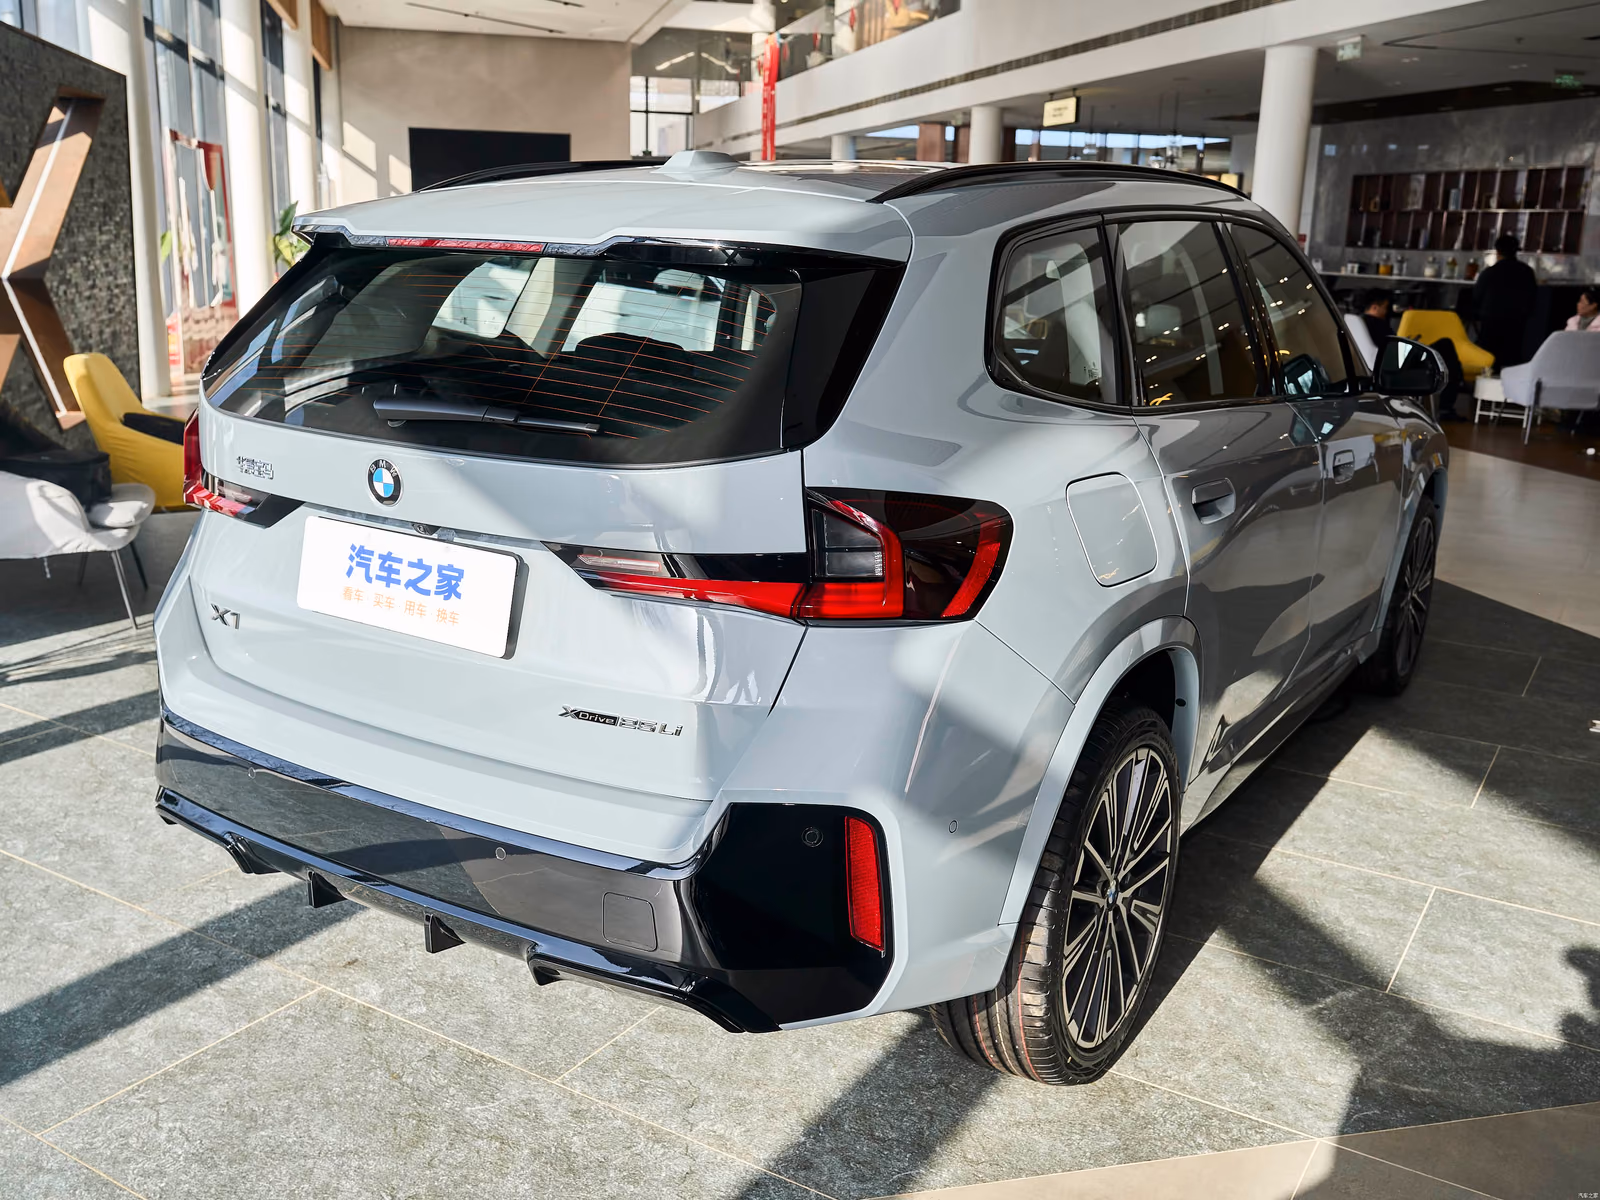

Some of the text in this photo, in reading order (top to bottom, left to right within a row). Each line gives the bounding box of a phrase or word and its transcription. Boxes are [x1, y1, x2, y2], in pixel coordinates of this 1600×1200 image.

[369, 459, 398, 477] BMW
[345, 543, 465, 601] 汽车之家
[210, 603, 241, 630] X1
[342, 586, 460, 626] 看车 买车 用车 换车
